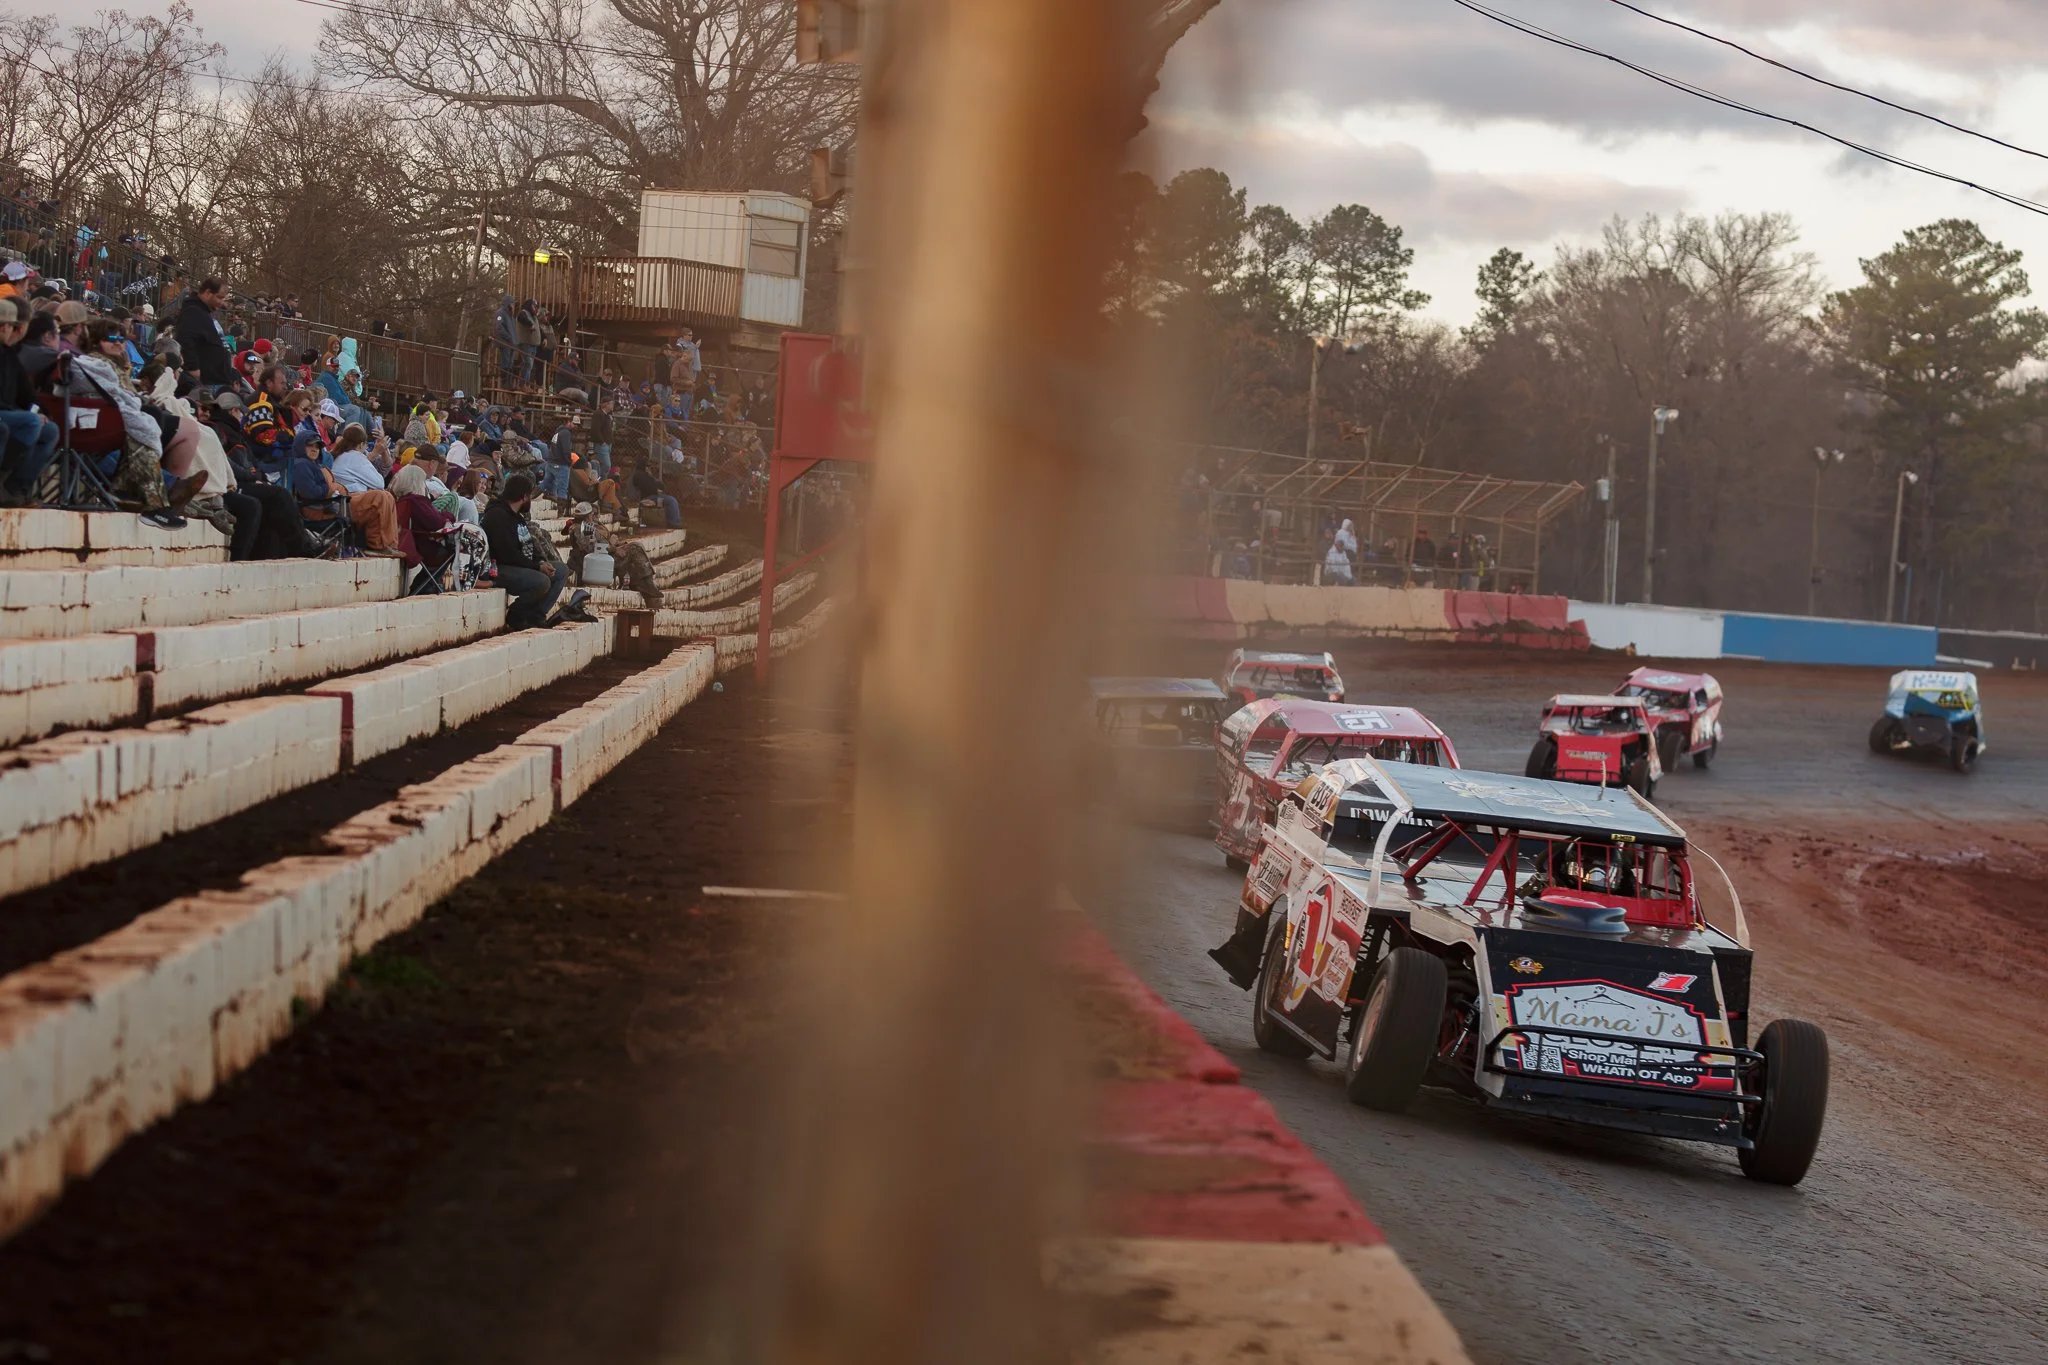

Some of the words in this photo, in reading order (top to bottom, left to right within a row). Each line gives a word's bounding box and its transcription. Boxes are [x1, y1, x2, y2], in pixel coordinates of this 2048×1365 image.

[1528, 996, 1637, 1033] Mama
[1645, 1010, 1691, 1038] J's
[1662, 1072, 1695, 1085] App
